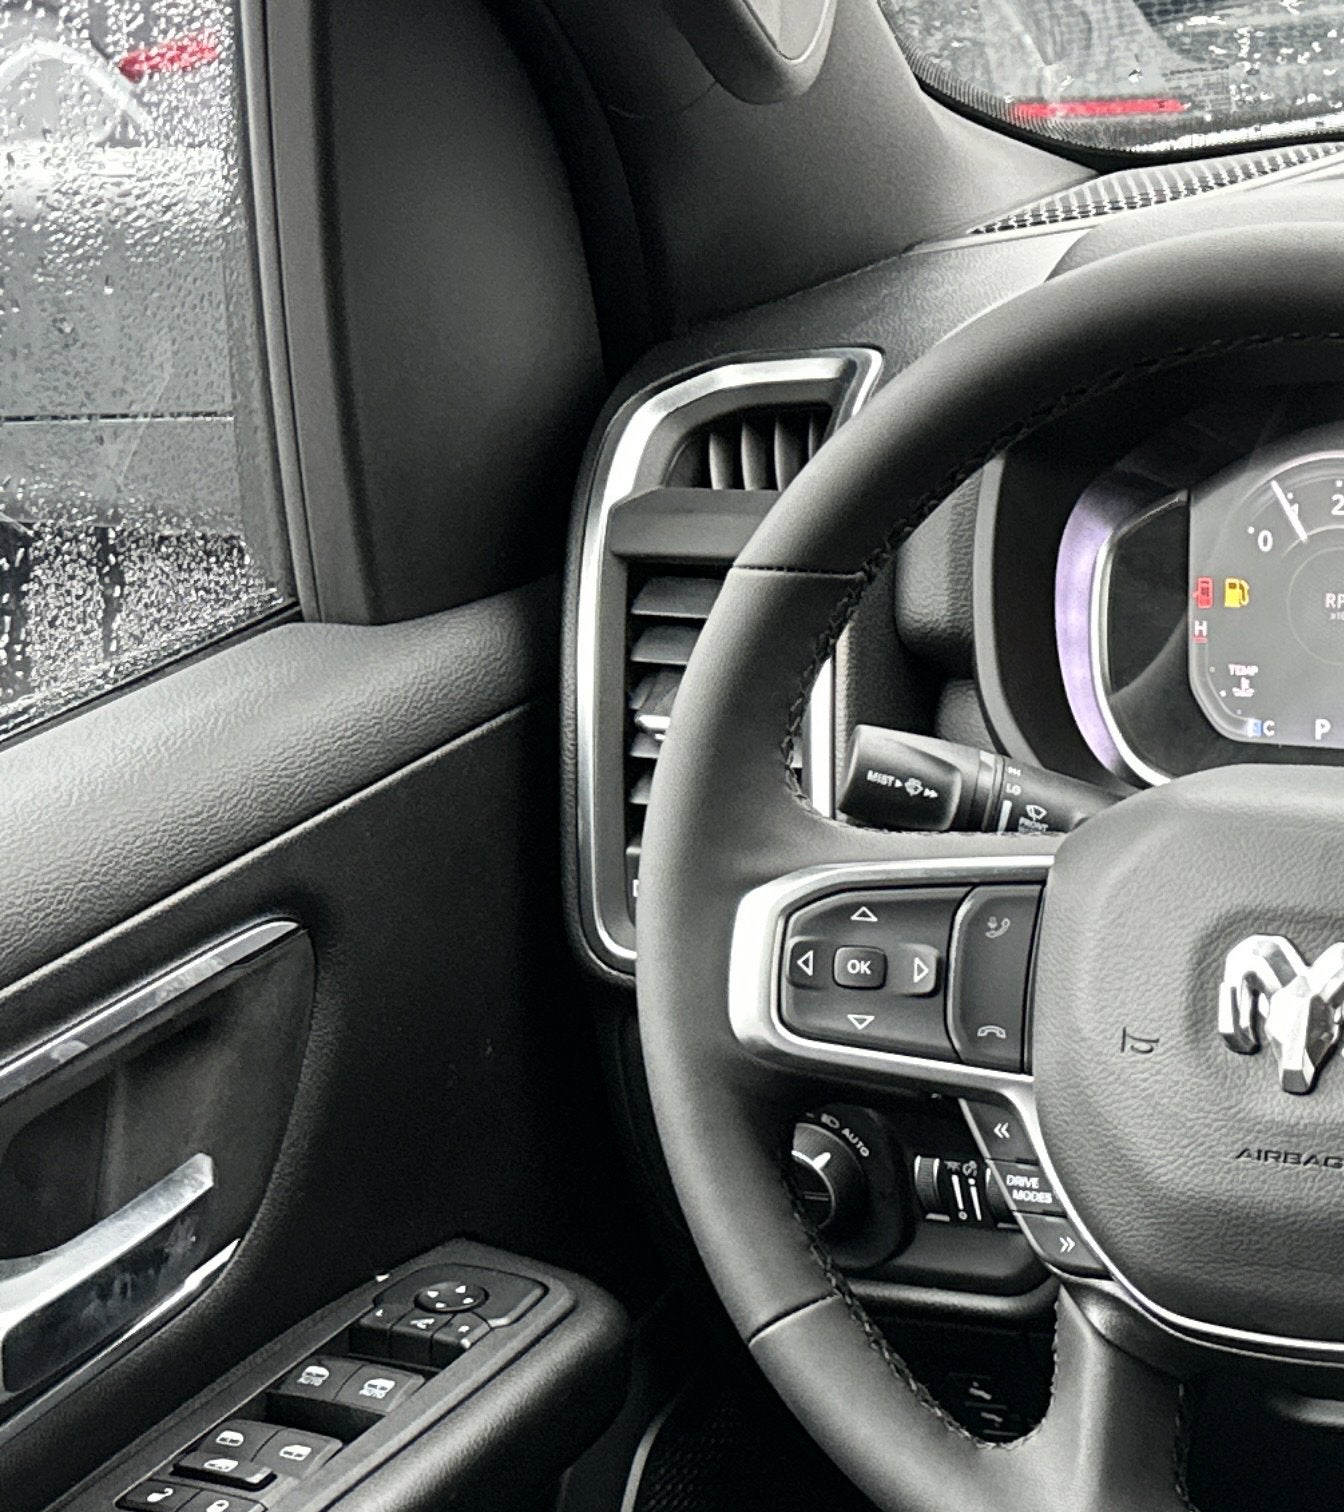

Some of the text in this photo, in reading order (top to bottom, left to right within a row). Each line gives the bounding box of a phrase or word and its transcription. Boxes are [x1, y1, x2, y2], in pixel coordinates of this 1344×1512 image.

[1257, 530, 1273, 552] 0
[1193, 620, 1208, 637] H
[1228, 663, 1259, 677] TEMP
[1262, 720, 1275, 736] C
[1315, 718, 1332, 740] P
[867, 769, 896, 788] MIST
[847, 958, 873, 976] OK
[841, 1126, 871, 1158] AUTO
[1006, 1174, 1040, 1190] DRIVE
